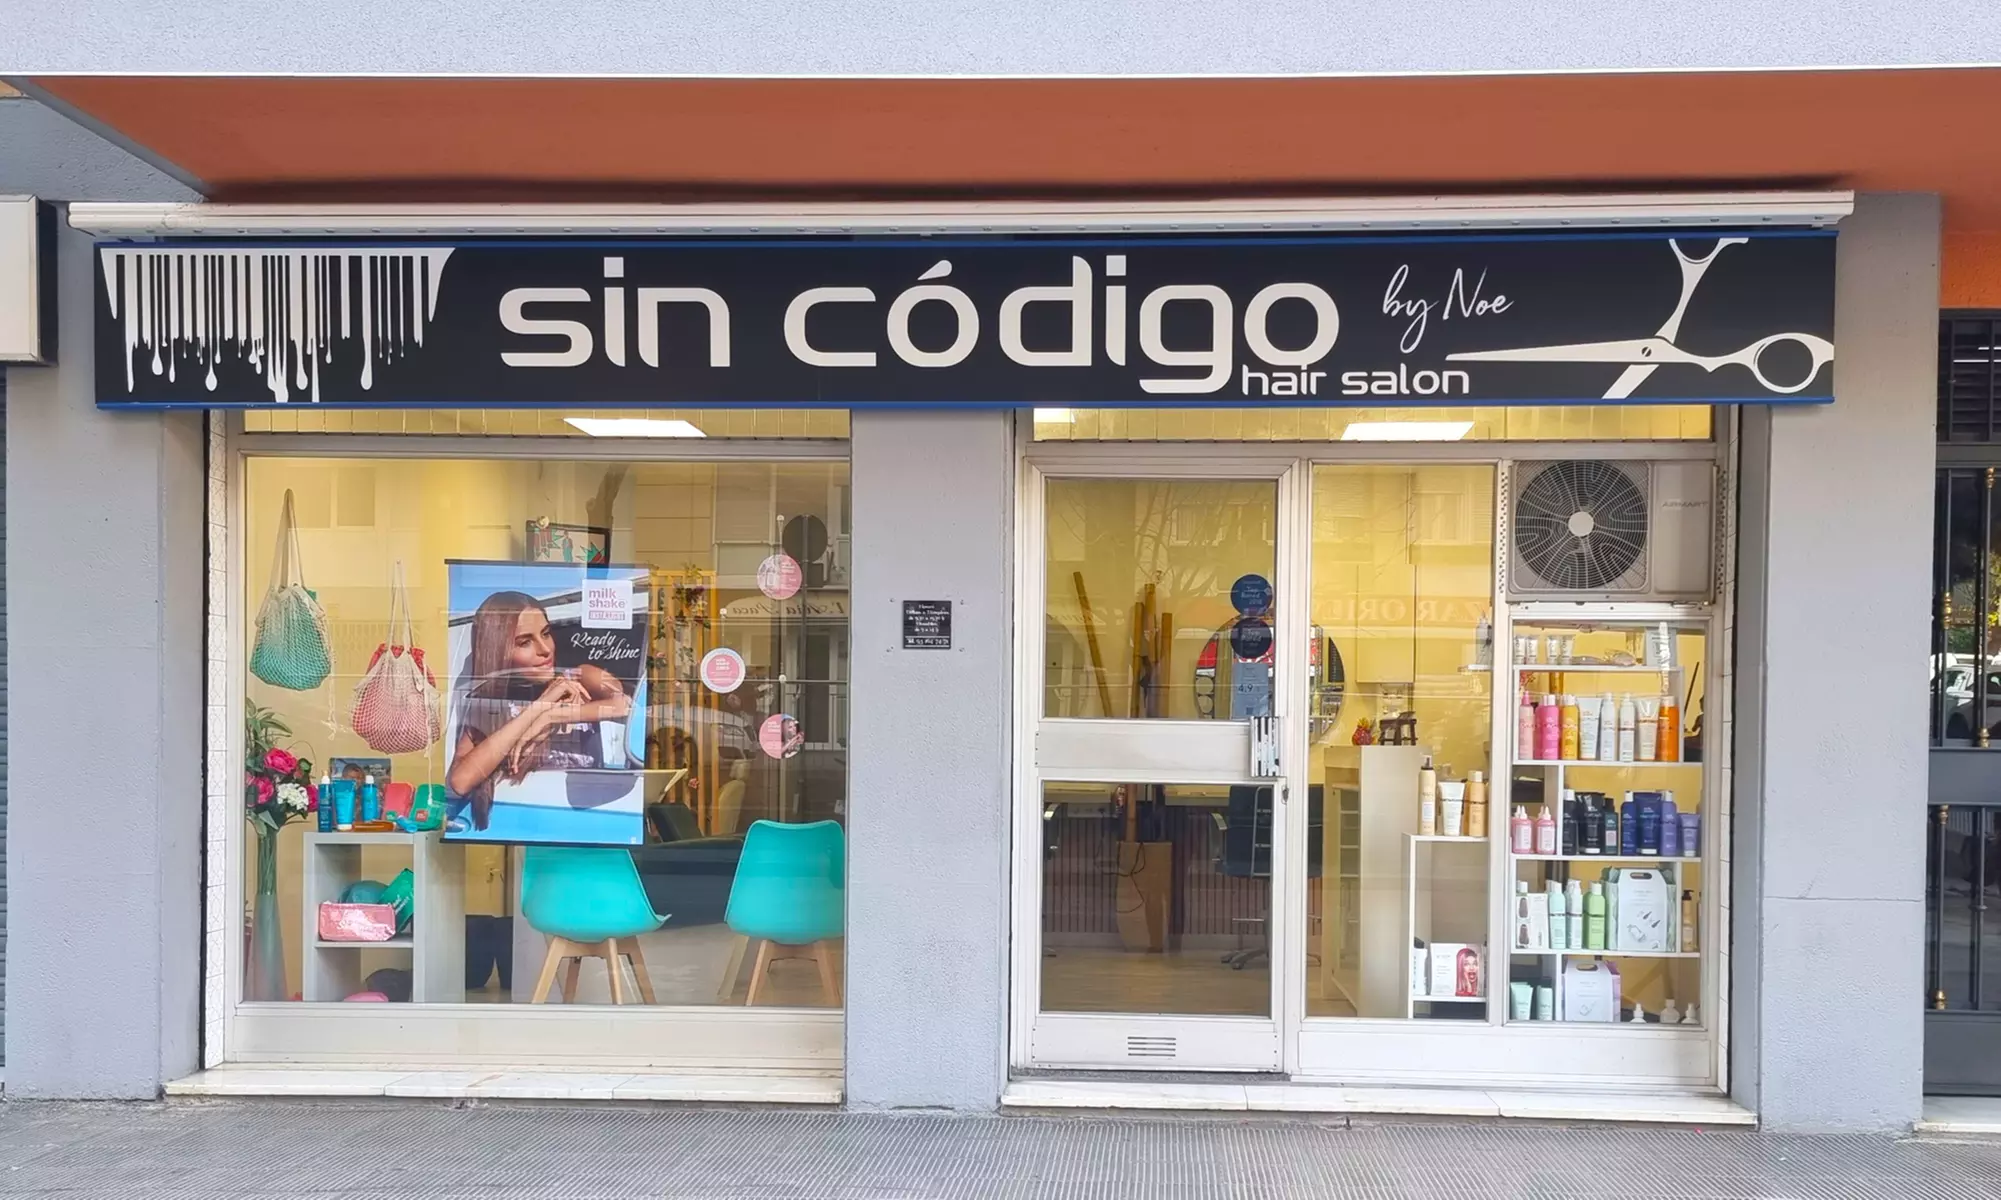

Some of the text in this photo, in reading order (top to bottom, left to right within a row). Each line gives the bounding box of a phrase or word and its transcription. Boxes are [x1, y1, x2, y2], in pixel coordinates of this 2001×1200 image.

[1382, 264, 1514, 355] by Noe
[499, 255, 1340, 394] sin código
[1241, 362, 1470, 396] hair salon
[588, 587, 617, 599] milk
[588, 598, 626, 609] shake
[570, 631, 617, 651] Ready
[588, 638, 641, 661] to shine
